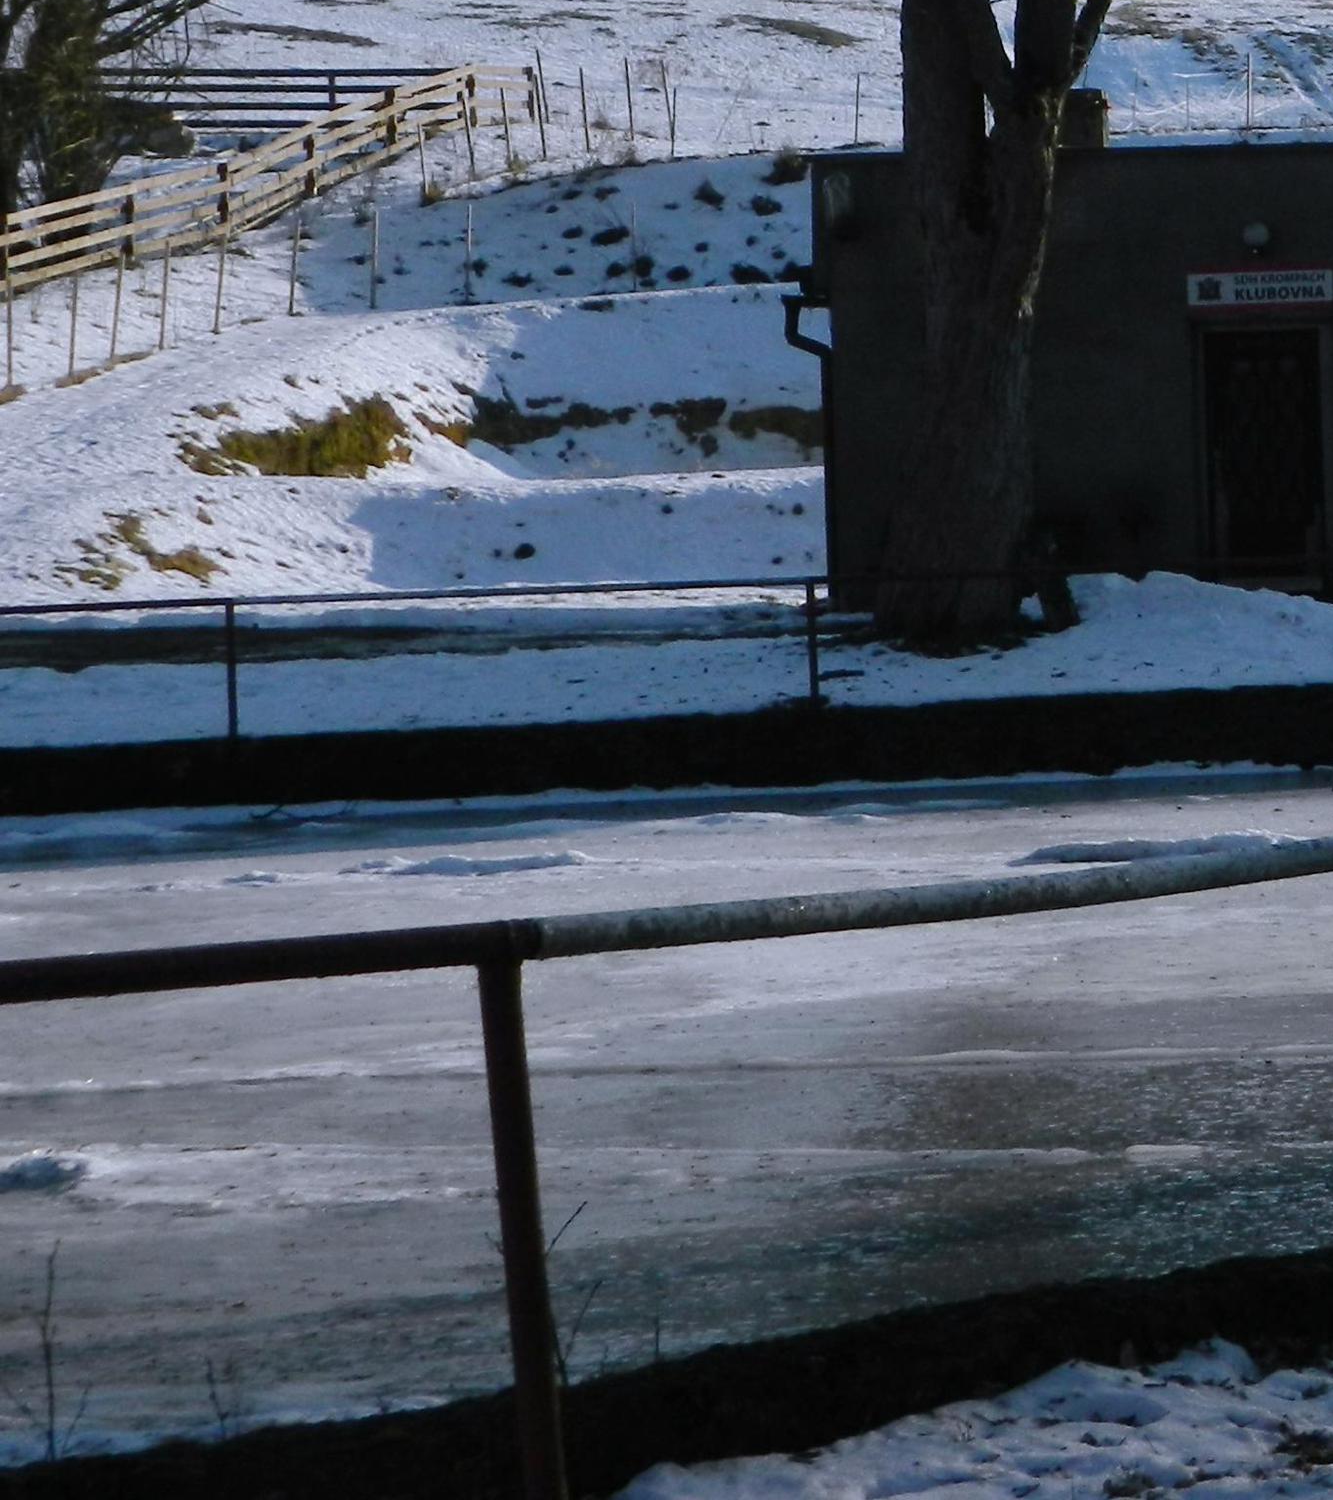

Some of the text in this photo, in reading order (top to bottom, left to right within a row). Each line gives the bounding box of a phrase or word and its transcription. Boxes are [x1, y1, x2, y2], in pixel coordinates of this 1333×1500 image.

[1234, 273, 1326, 285] SDH KROMPACH
[1235, 286, 1326, 300] KLUBOVNA
